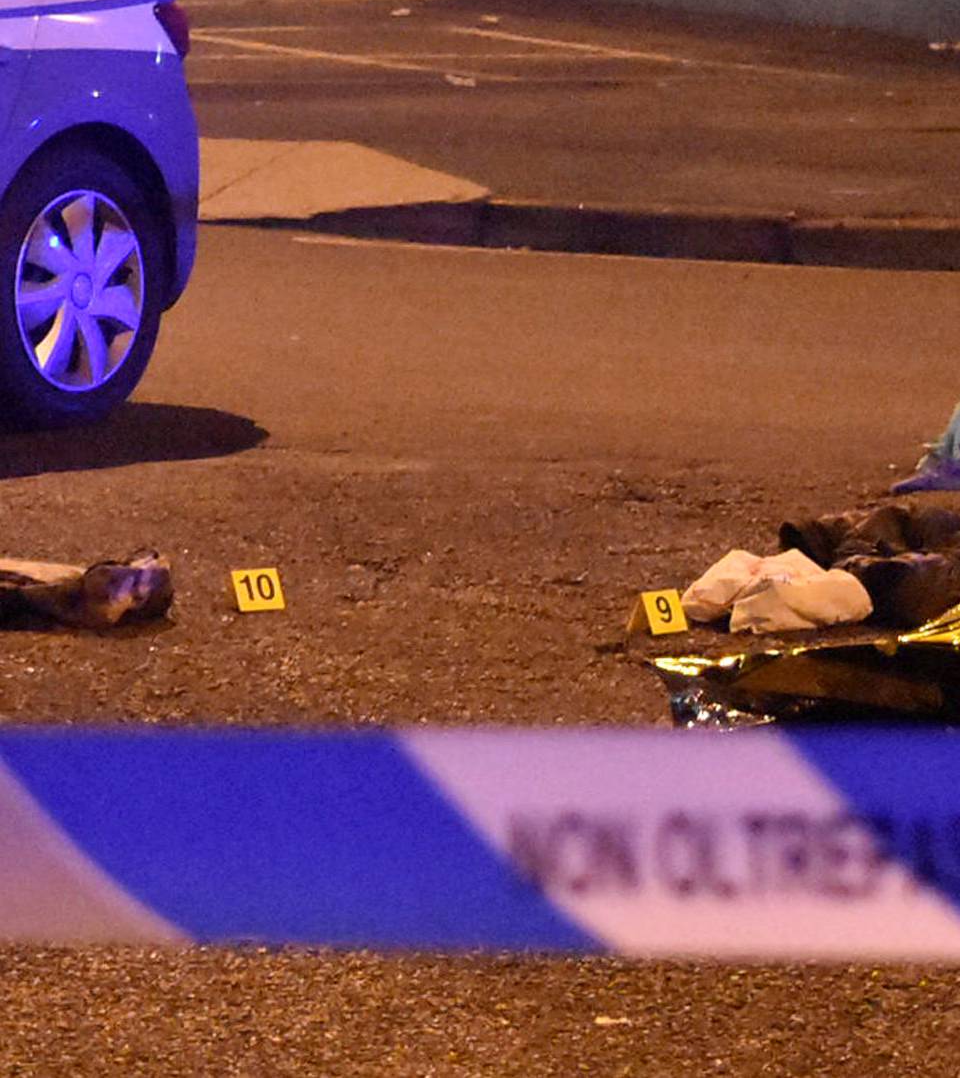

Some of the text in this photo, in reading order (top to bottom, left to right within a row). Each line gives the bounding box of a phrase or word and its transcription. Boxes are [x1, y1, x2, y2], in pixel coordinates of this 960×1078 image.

[238, 574, 275, 601] 10
[655, 595, 673, 624] 9
[506, 810, 640, 894] NON
